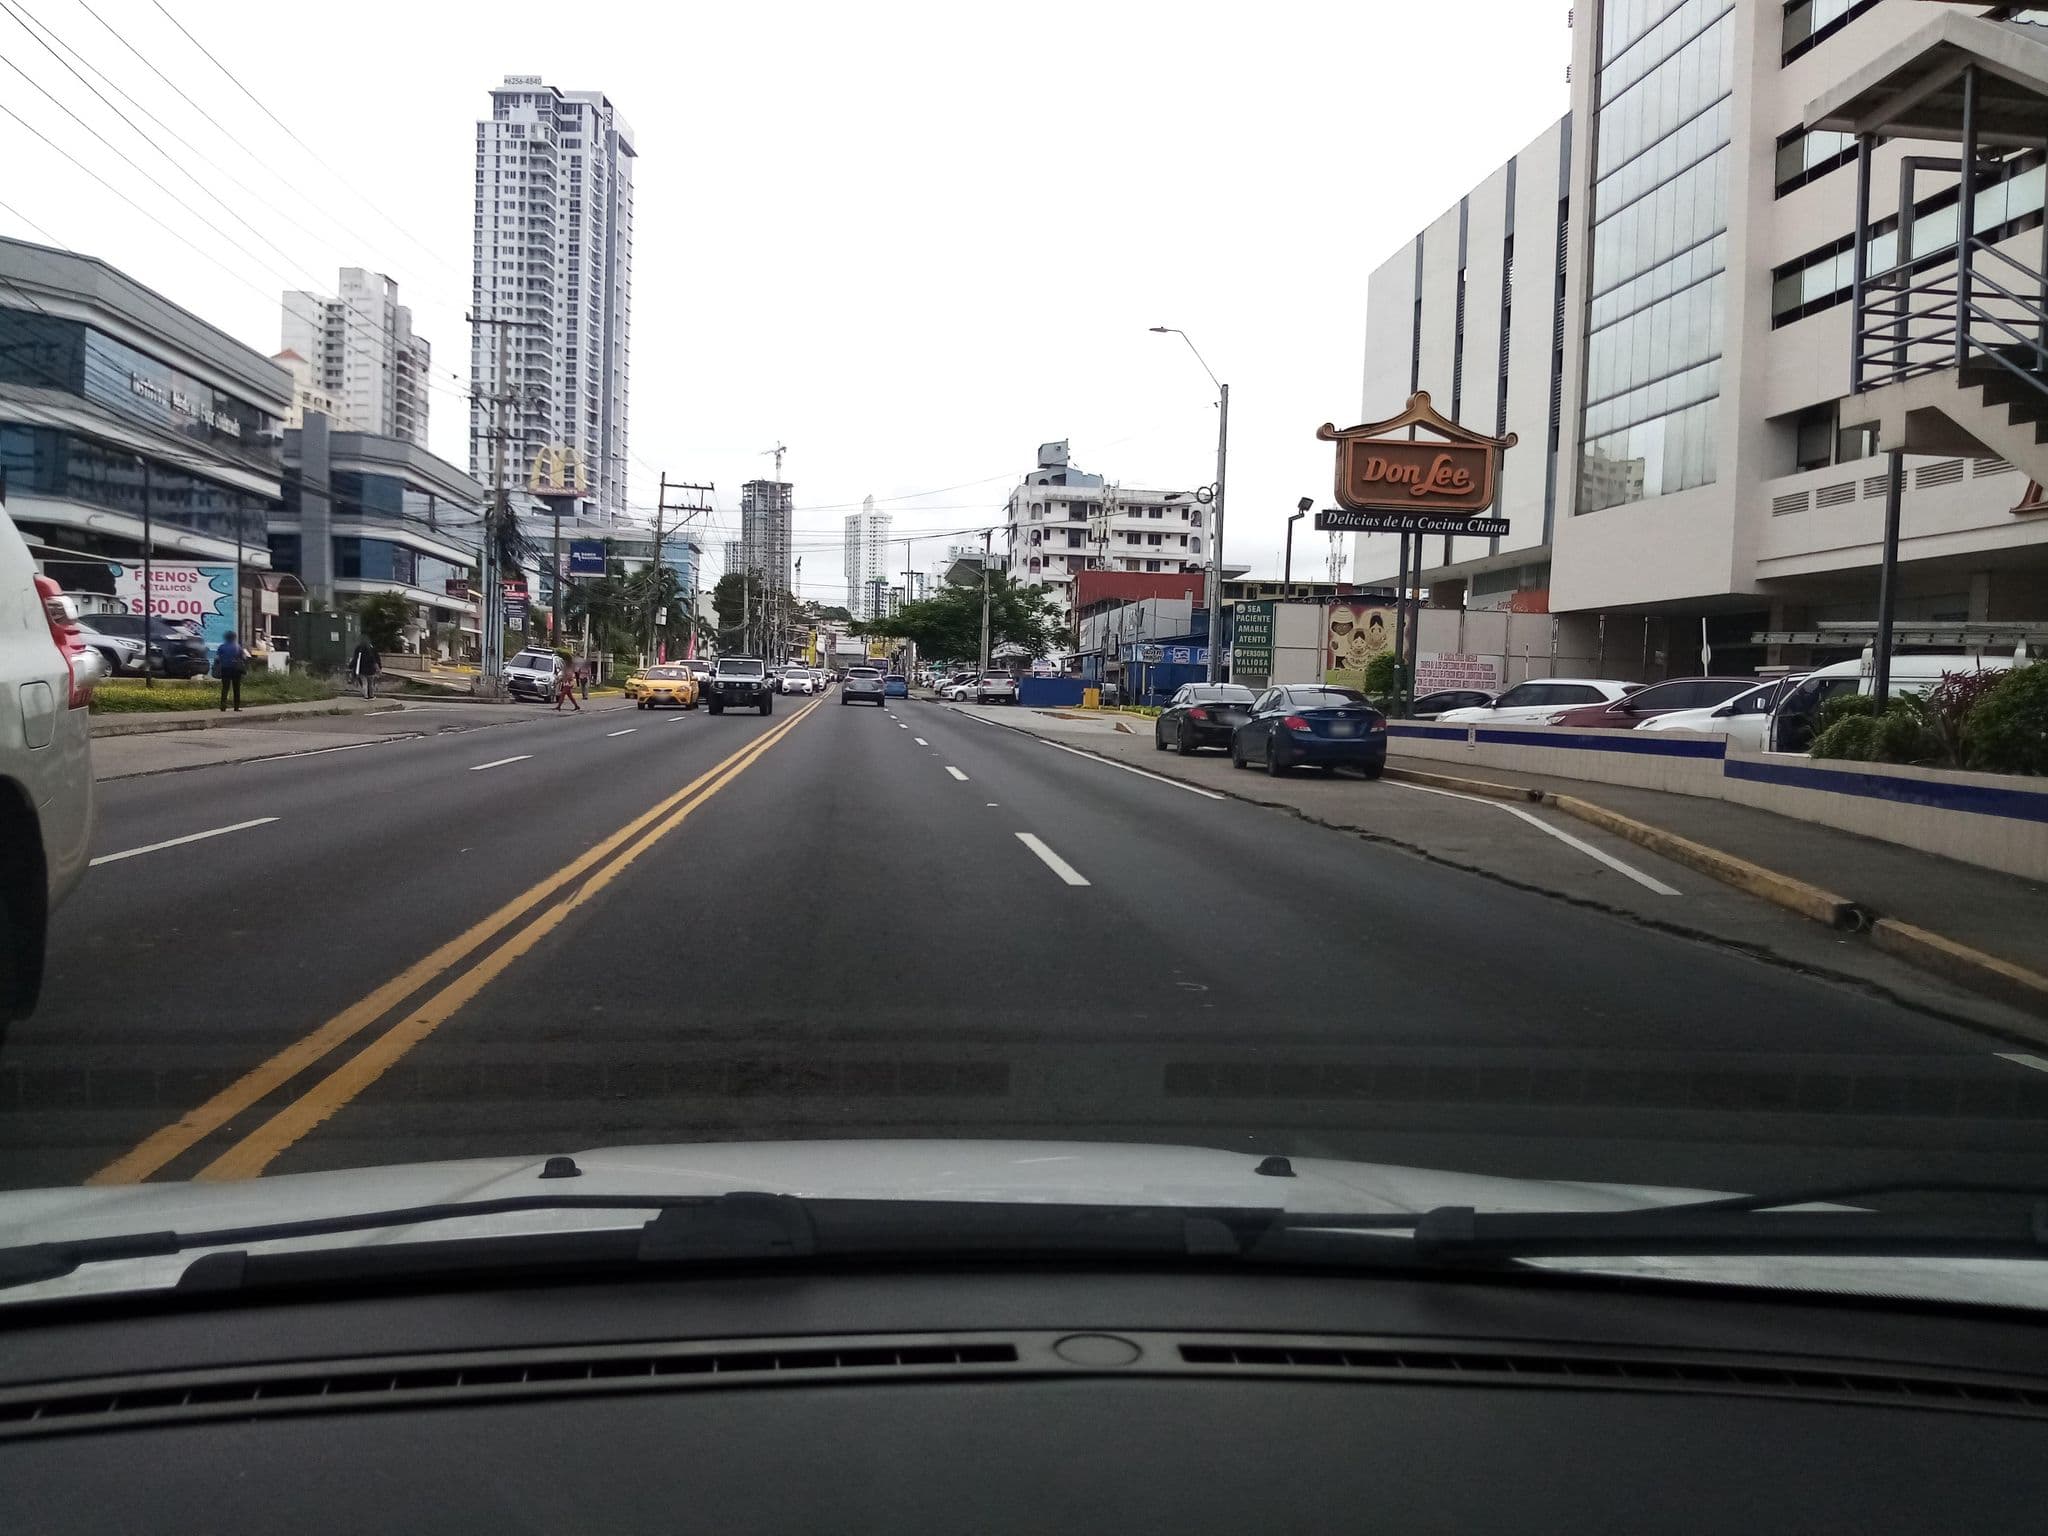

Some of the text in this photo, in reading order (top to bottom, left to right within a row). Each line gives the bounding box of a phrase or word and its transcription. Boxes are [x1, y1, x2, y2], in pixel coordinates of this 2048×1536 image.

[1362, 453, 1475, 496] Don Lee
[1327, 512, 1507, 533] Delicias de la Cocina China
[134, 571, 199, 584] FRENOS
[1247, 605, 1261, 613] SEA
[1236, 614, 1271, 623] PACIENTE
[1238, 625, 1269, 633] AMABLE
[1239, 635, 1267, 644] ATENTO
[1242, 649, 1269, 657] PERSONA
[1236, 658, 1268, 666] VALIOSA
